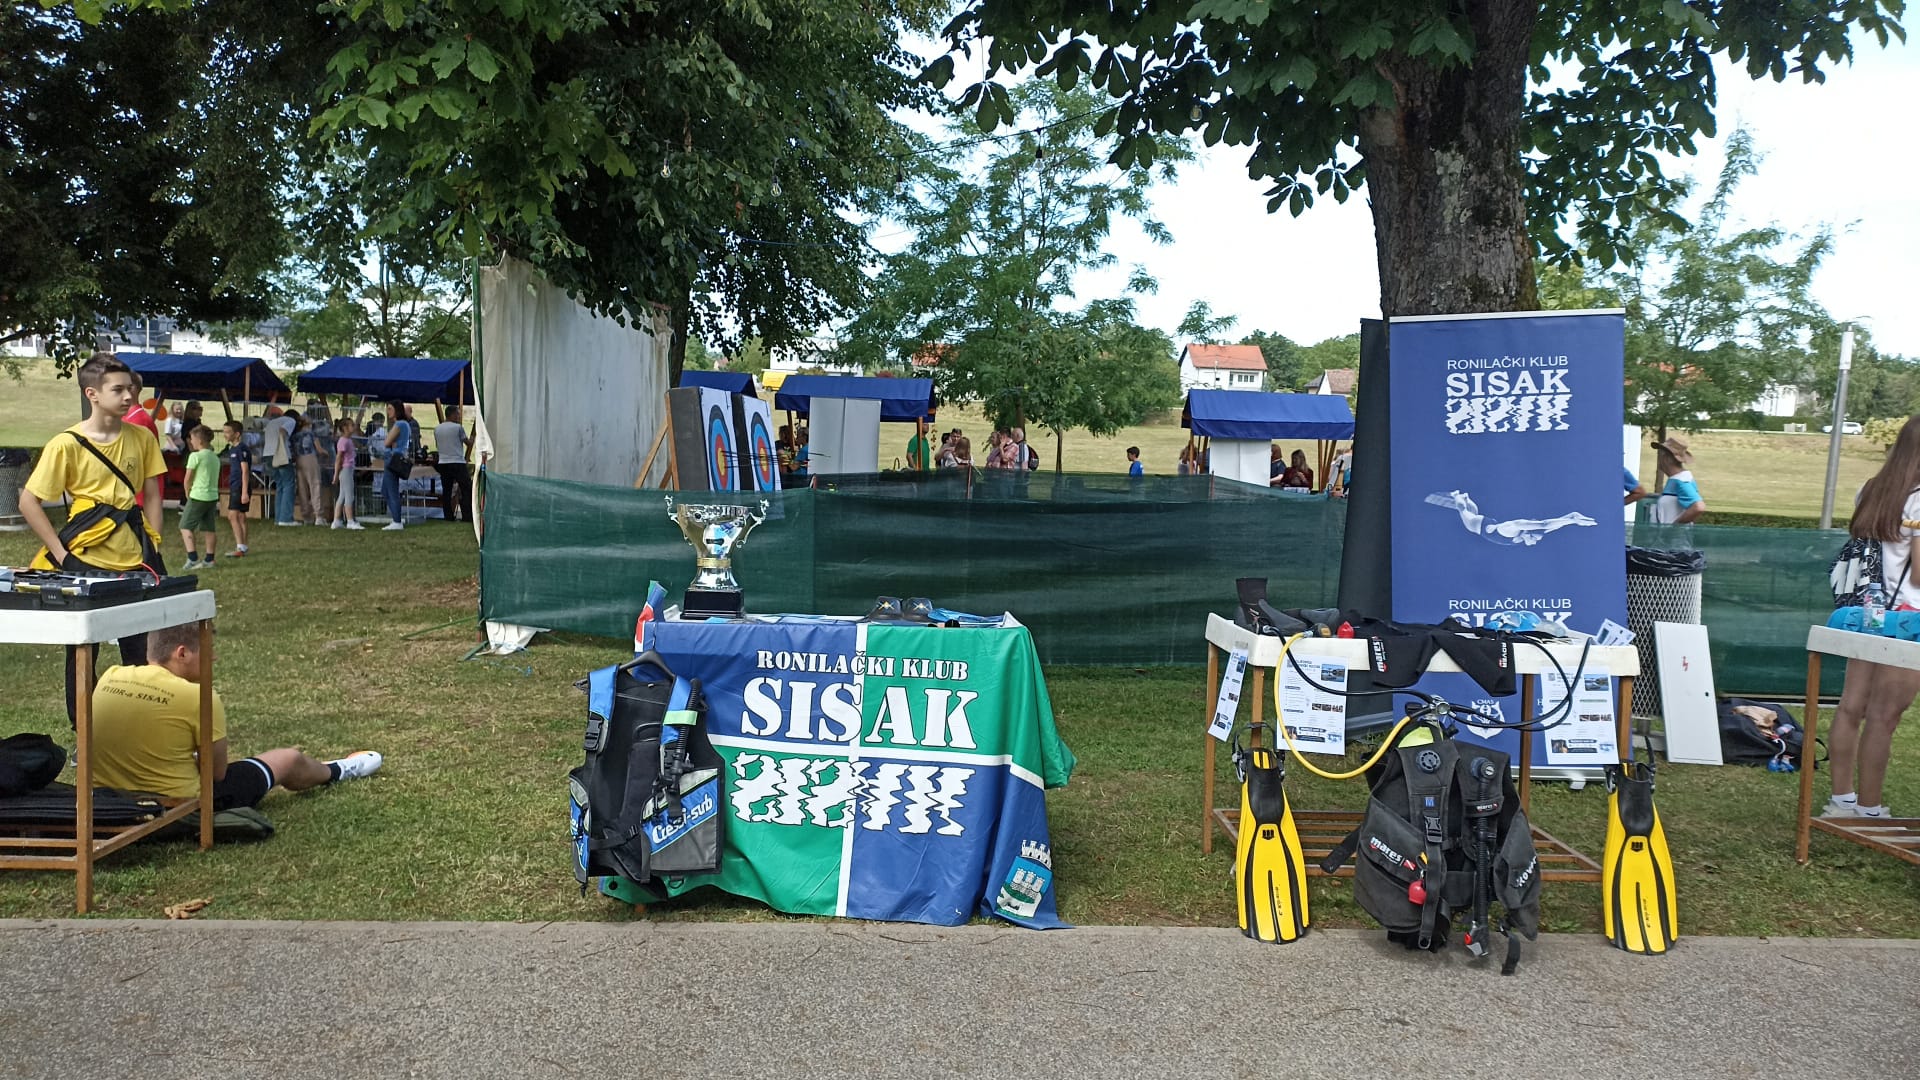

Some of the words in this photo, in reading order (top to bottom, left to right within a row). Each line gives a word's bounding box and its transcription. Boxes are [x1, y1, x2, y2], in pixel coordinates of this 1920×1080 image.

[1447, 355, 1526, 370] RONILAČKI
[1530, 355, 1569, 367] KLUB
[1446, 368, 1571, 397] SISAK
[1449, 597, 1528, 610] RONILAČKI
[1532, 598, 1572, 609] KLUB
[757, 650, 896, 677] RONILAČKI
[902, 658, 969, 681] KLUB
[741, 676, 979, 750] SISAK
[1370, 836, 1402, 863] mares
